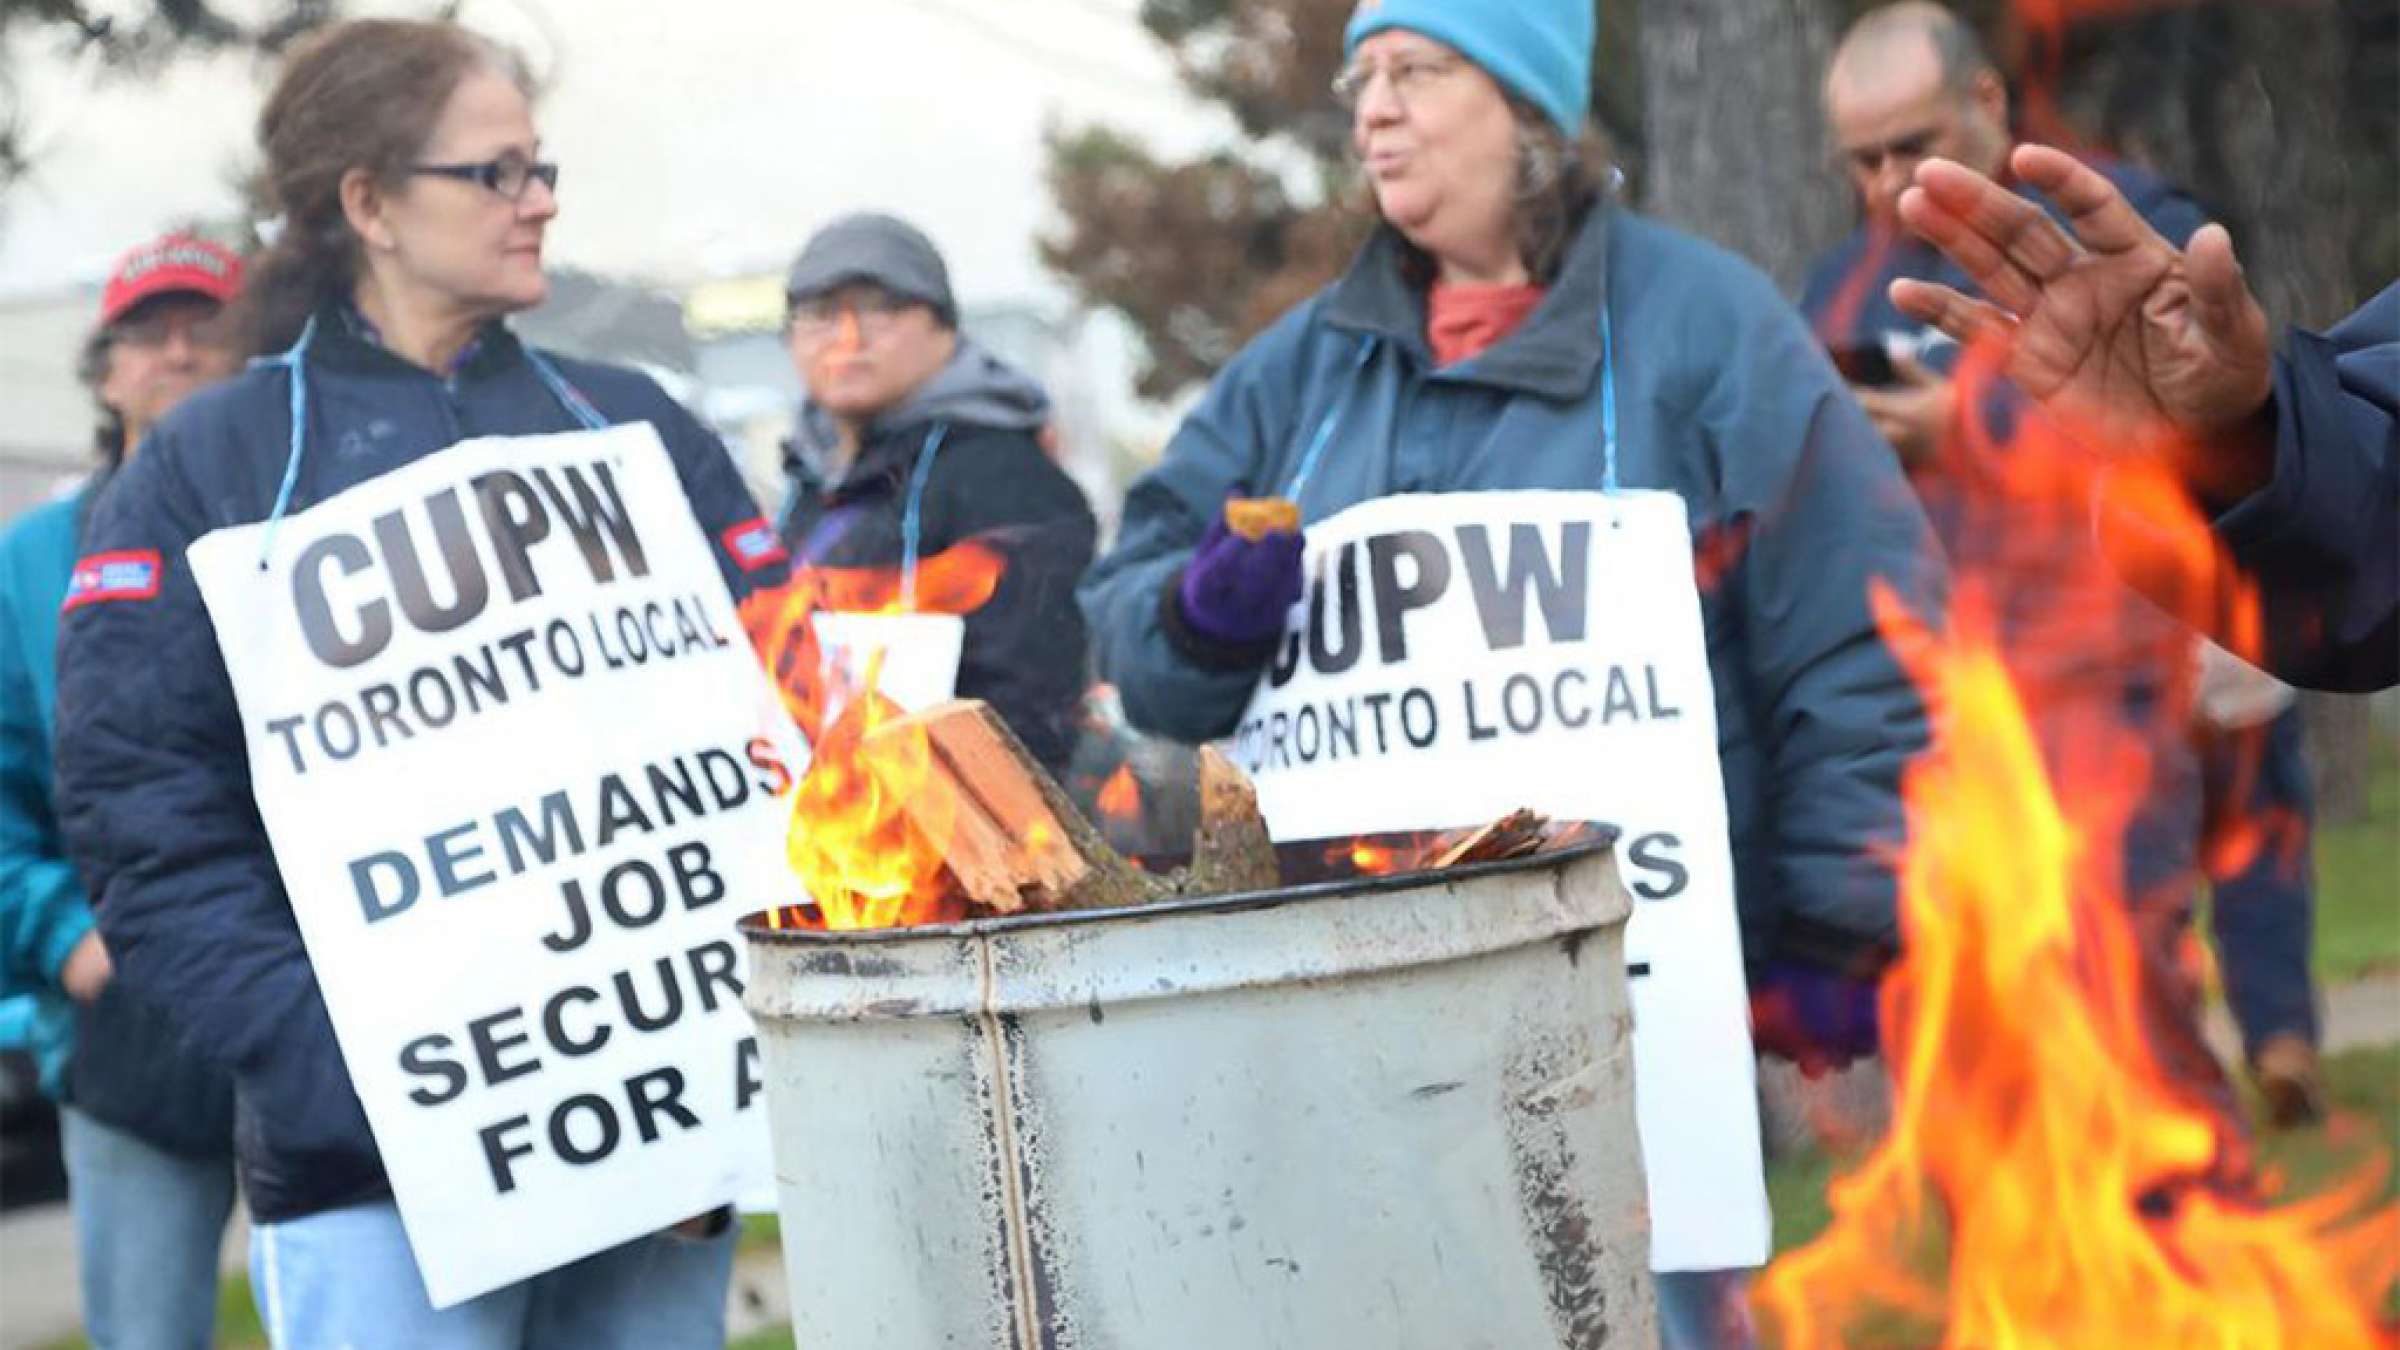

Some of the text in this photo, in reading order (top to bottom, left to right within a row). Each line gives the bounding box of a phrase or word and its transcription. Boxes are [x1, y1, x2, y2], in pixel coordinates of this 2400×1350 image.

[292, 460, 650, 669] CUPW
[266, 593, 729, 775] TORONTO LOCAL
[1462, 662, 1682, 743] LOCAL
[346, 737, 793, 924] DEMANDS
[540, 839, 727, 953] JOB
[397, 939, 747, 1108] SECUR
[478, 1065, 703, 1195] FOR
